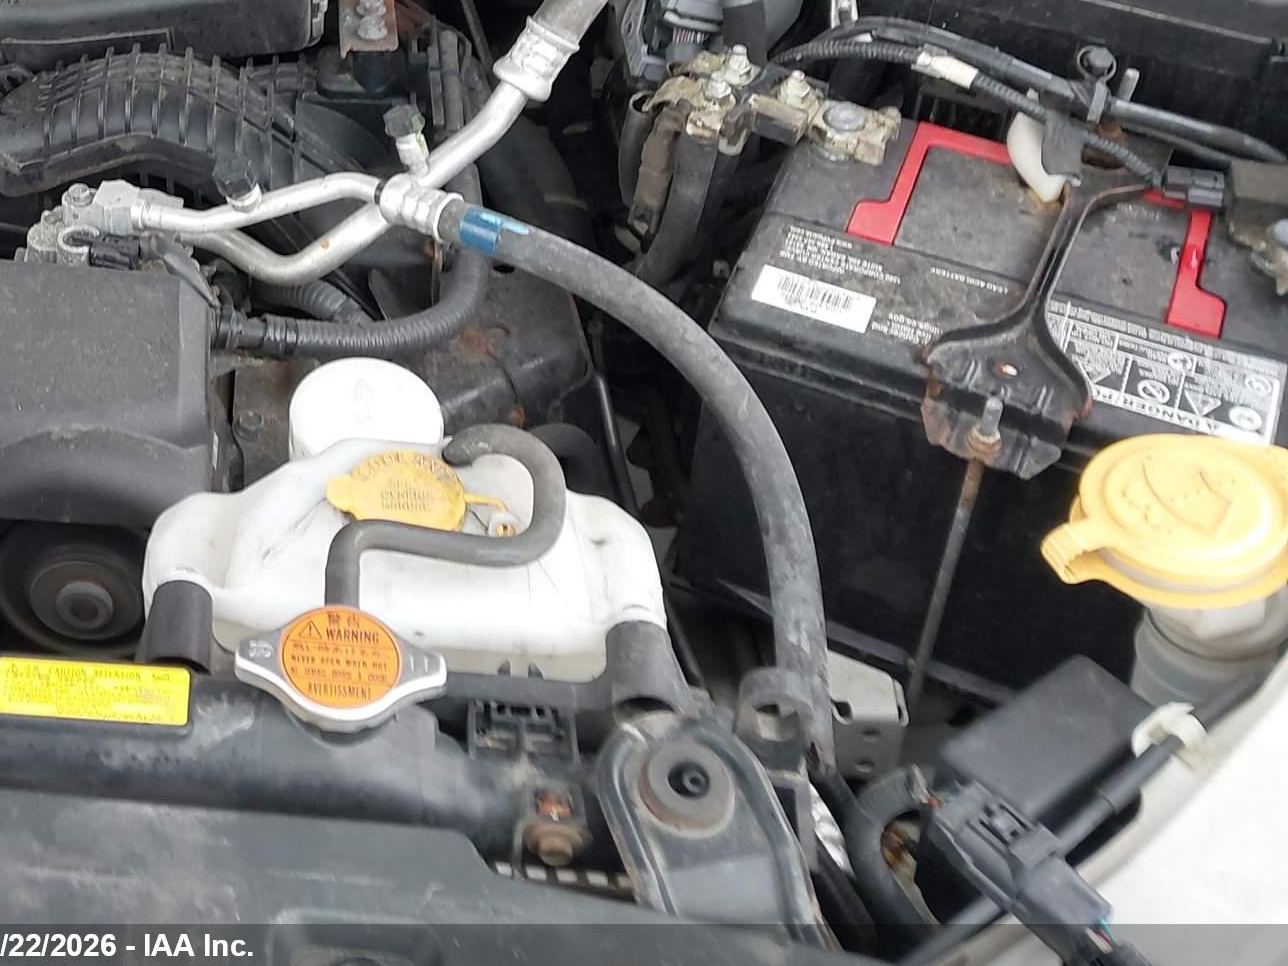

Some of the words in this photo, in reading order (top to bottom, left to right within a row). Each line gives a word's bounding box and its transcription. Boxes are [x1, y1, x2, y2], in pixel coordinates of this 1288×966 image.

[326, 628, 380, 644] WARNING
[48, 665, 87, 678] CAUTION
[93, 668, 141, 681] ATTENTION
